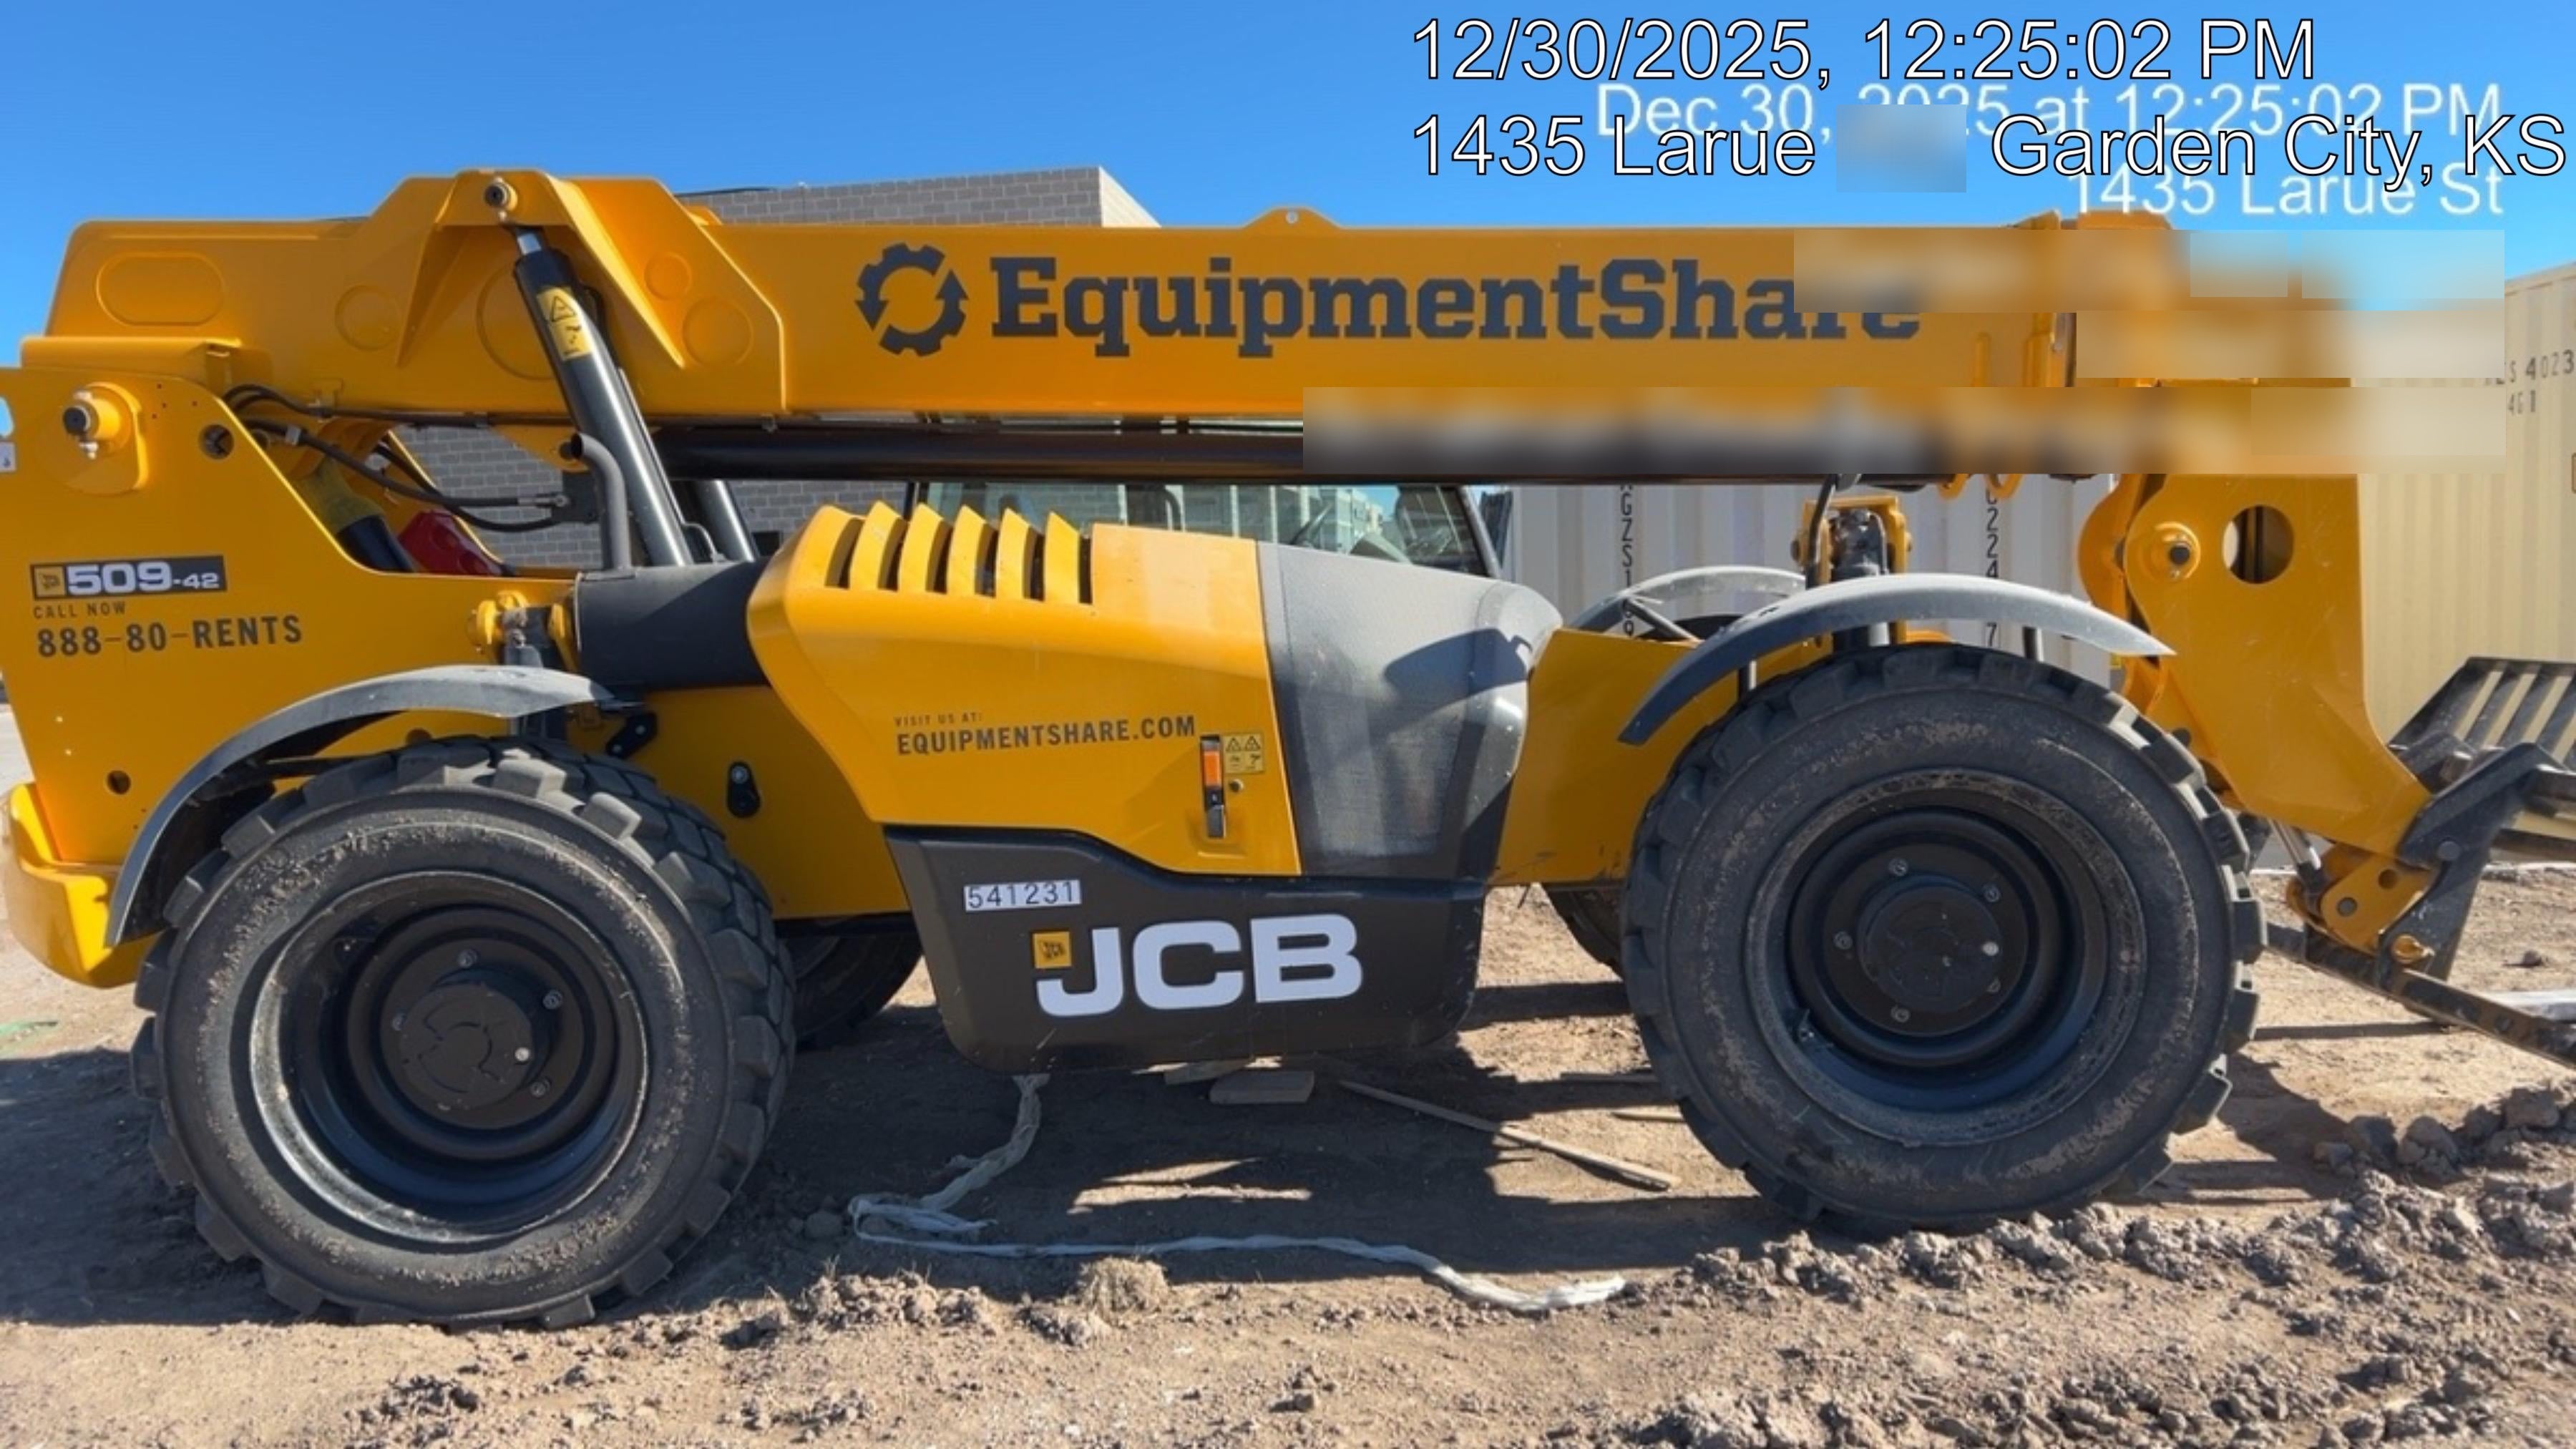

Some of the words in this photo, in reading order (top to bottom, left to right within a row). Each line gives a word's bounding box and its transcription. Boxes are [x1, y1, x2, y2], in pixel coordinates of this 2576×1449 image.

[67, 562, 220, 595] 509-42
[34, 605, 77, 620] CALL
[87, 601, 126, 615] NOW
[37, 615, 302, 658] 888-80-RENTS
[894, 715, 930, 727] VISIT
[938, 713, 955, 724] US
[897, 716, 1196, 756] EQUIPMENTSHARE.COM
[967, 881, 1075, 907] 541231
[1036, 914, 1362, 1016] JCB
